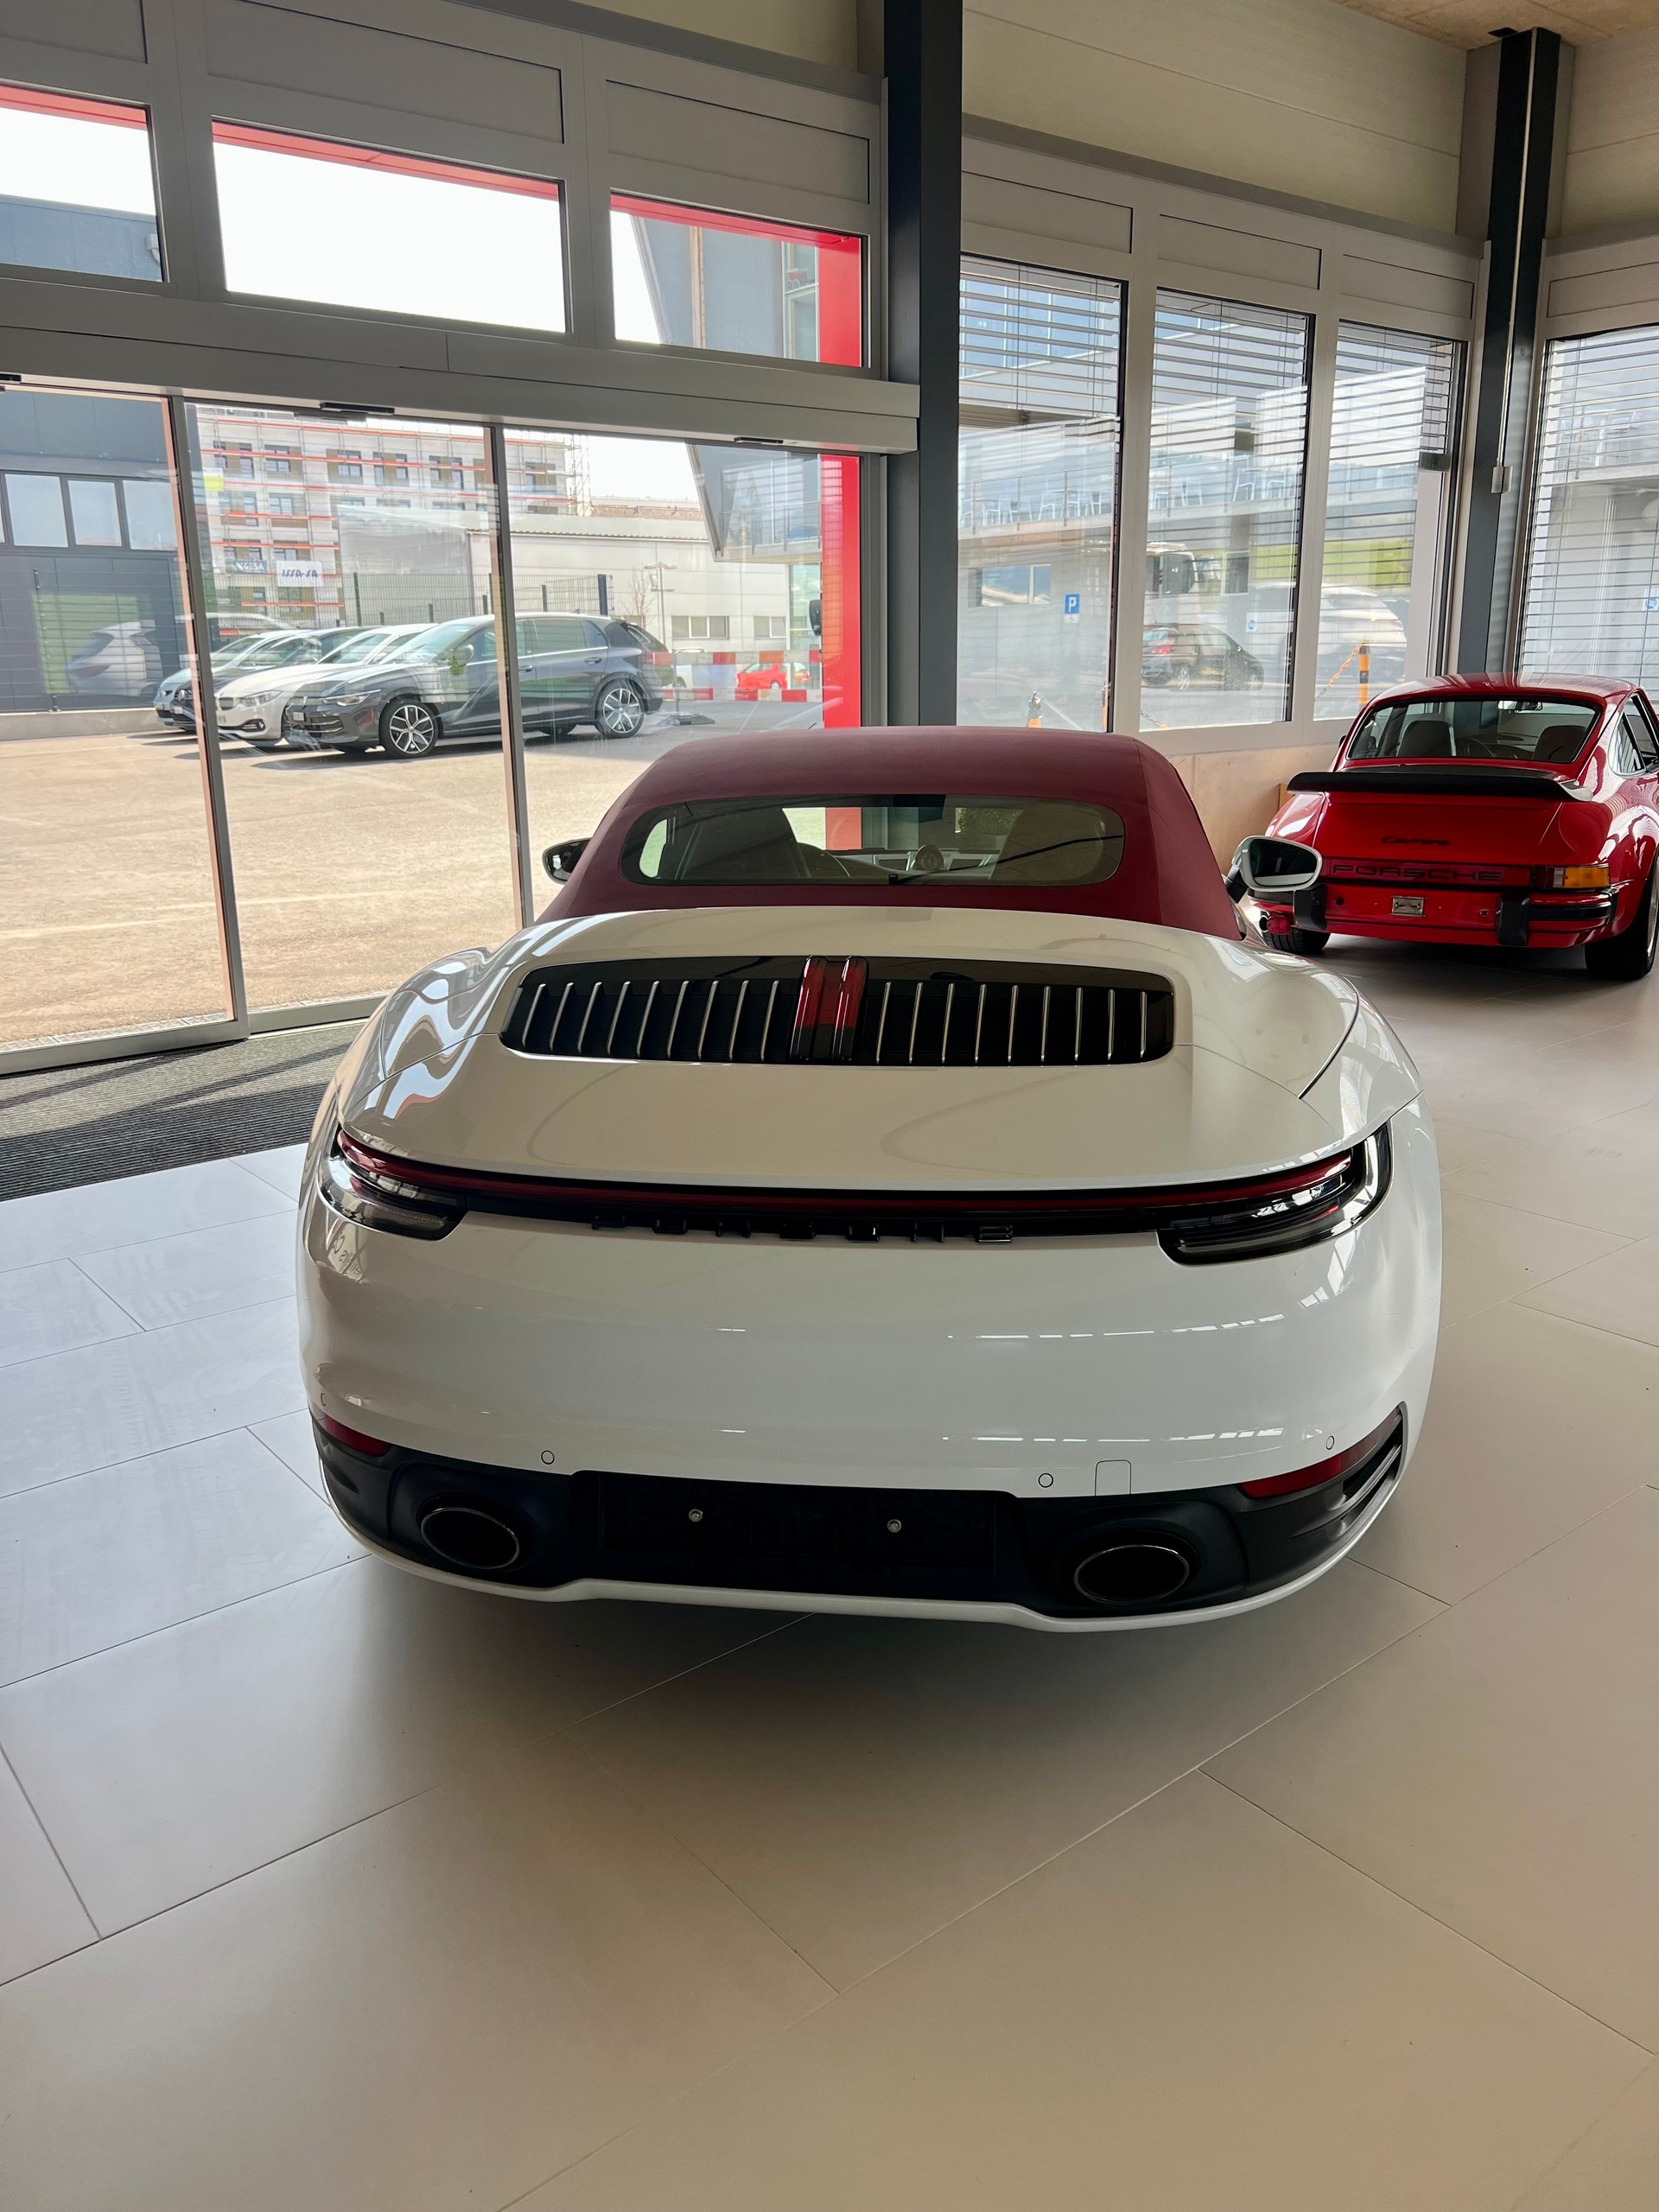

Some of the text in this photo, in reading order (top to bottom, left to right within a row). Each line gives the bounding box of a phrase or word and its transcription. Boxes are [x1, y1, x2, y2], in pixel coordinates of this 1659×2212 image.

[1068, 596, 1077, 613] P
[1381, 836, 1451, 846] Carrera
[1332, 864, 1503, 882] PORSCHE
